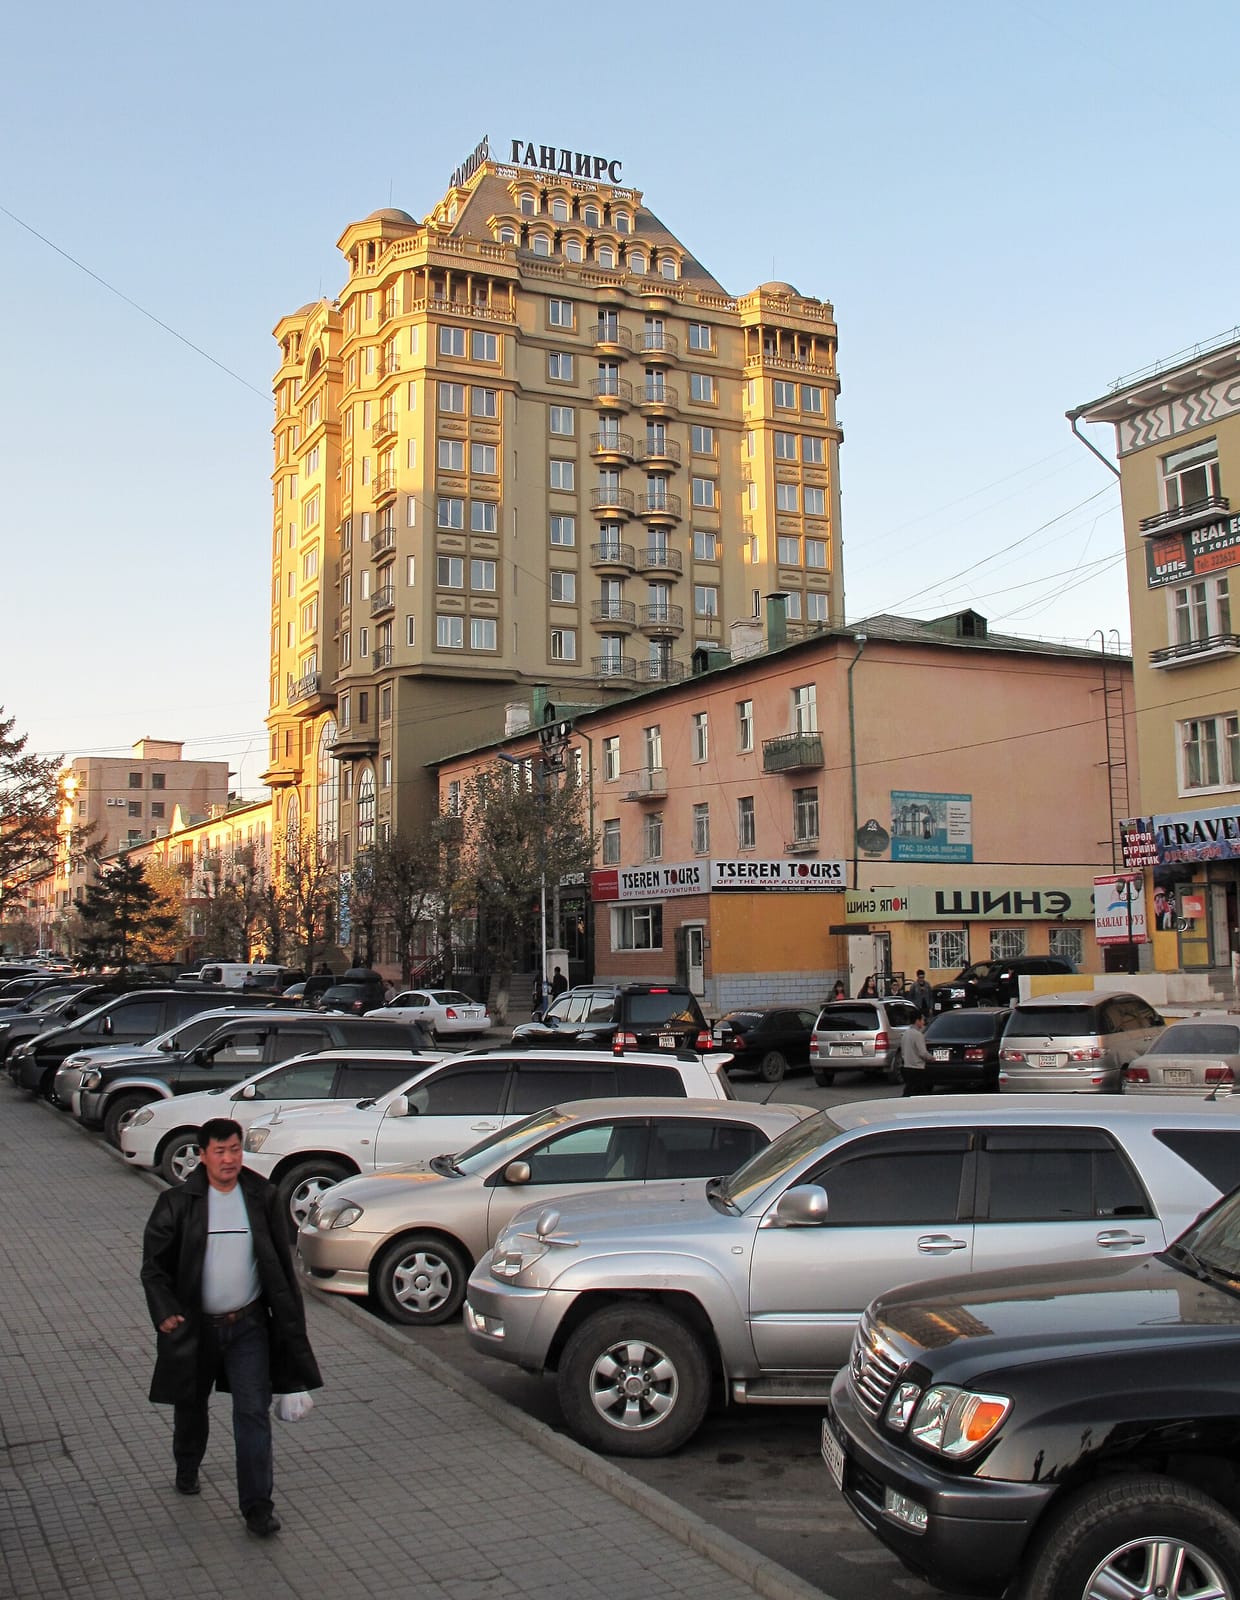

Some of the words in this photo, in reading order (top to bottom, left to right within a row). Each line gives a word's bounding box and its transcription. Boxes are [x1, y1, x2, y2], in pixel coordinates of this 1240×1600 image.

[511, 139, 623, 184] ГАНДИРС
[1191, 523, 1226, 545] REAL
[622, 870, 660, 889] TSEREN
[664, 867, 700, 885] TOURS
[716, 863, 780, 879] TSEREN
[788, 864, 841, 879] TOURS
[660, 886, 701, 895] ADVENTURES
[846, 901, 876, 914] ШИНЭ
[879, 897, 908, 912] ЯПОН
[935, 891, 1072, 915] ШИНЭ
[1096, 916, 1123, 928] БАЯЛАГ
